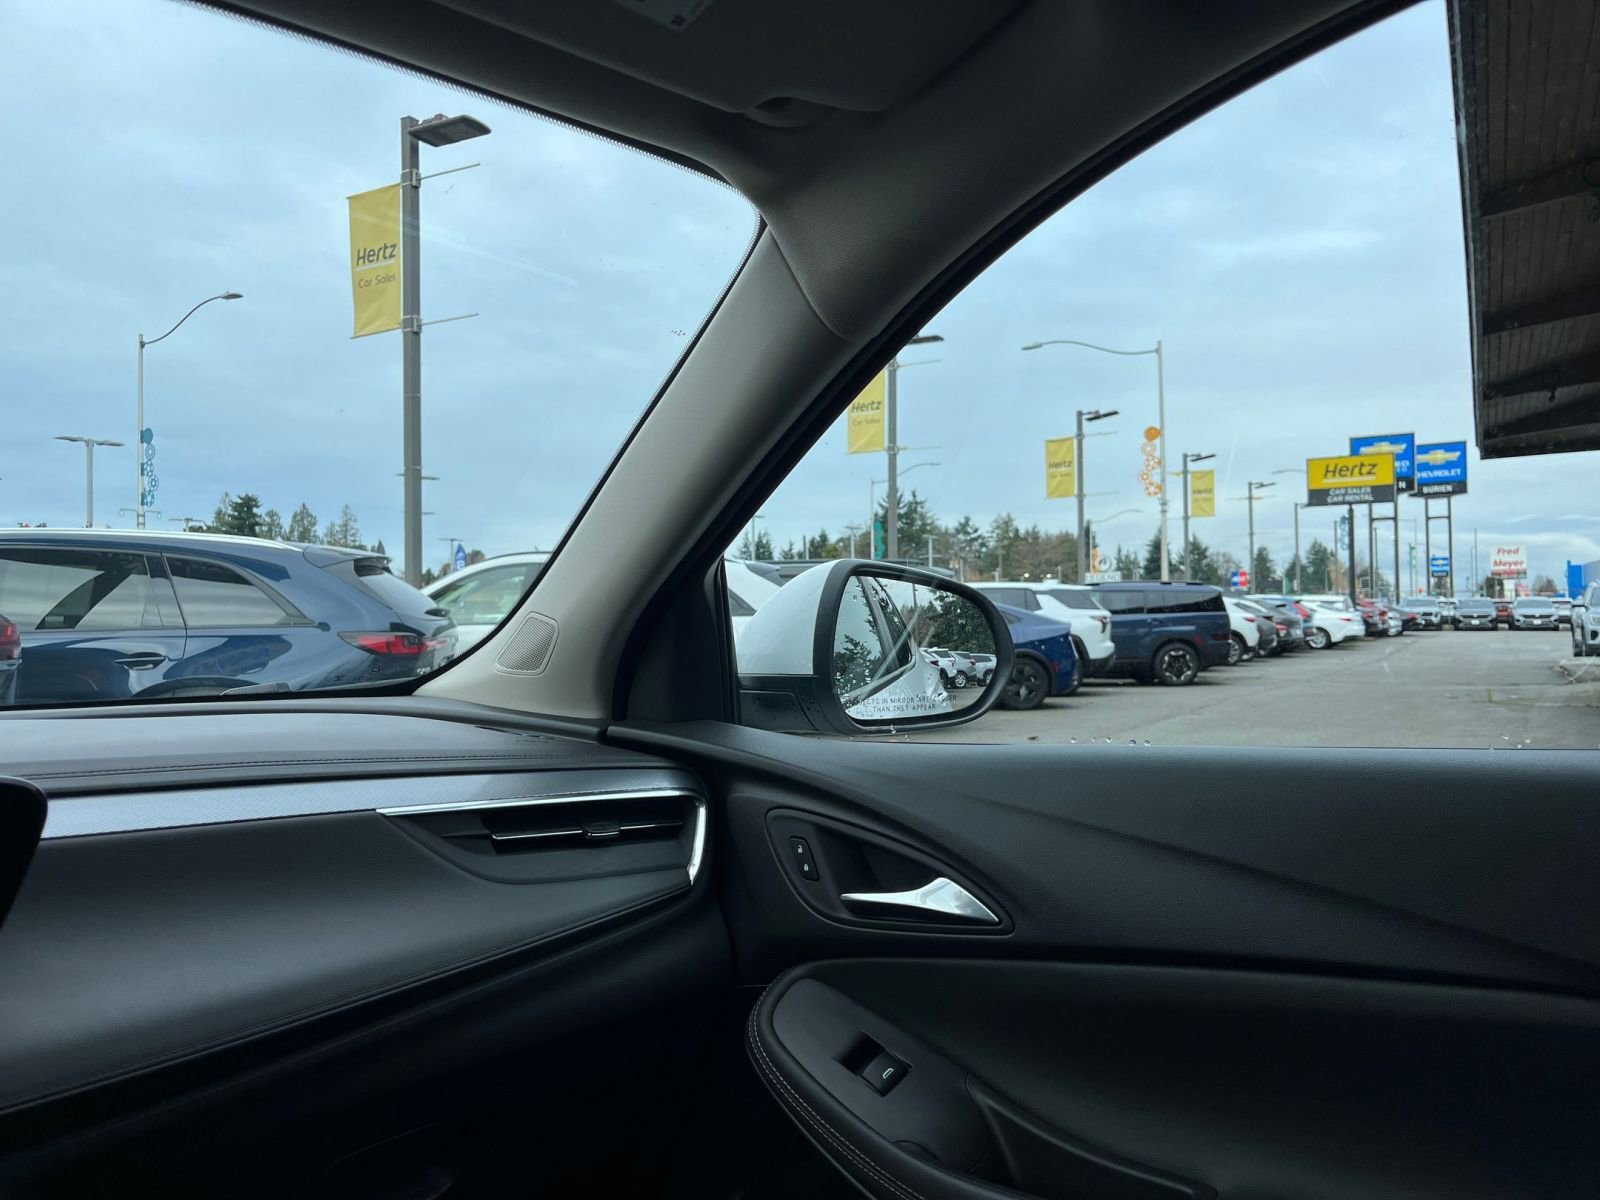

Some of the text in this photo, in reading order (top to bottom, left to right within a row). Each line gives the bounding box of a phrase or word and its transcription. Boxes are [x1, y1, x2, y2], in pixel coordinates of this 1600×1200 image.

[356, 243, 397, 266] Hertz
[358, 273, 396, 289] Car Sales
[851, 401, 882, 413] Hertz
[1324, 462, 1378, 478] Hertz
[1497, 547, 1520, 556] Fred
[1493, 559, 1524, 568] Meyer
[889, 696, 915, 704] MIRROR
[873, 702, 937, 713] THAN THEY APPEAR
